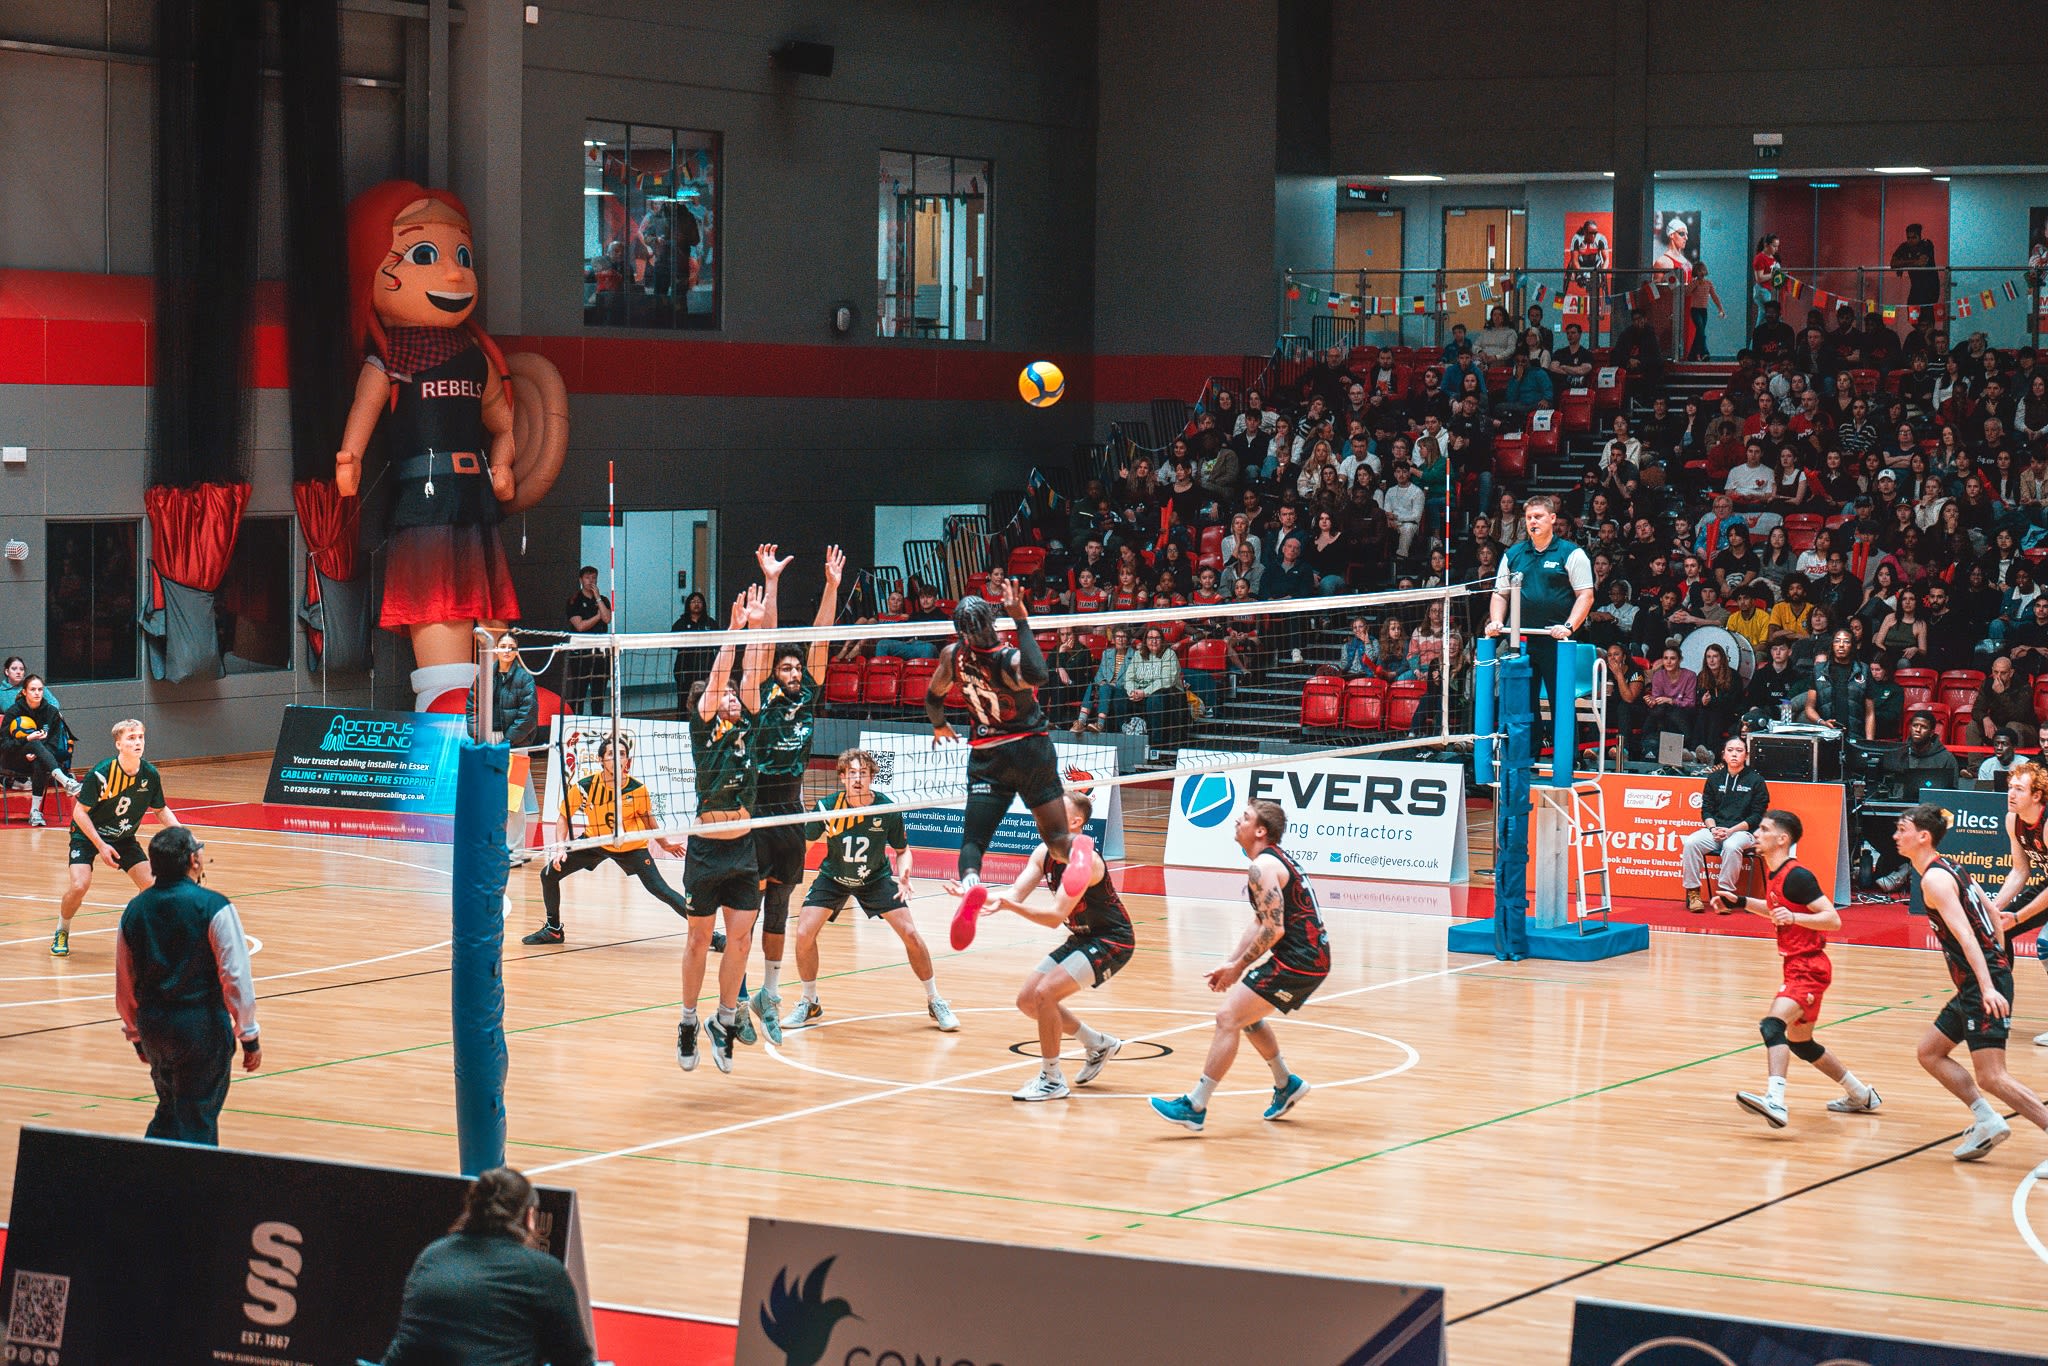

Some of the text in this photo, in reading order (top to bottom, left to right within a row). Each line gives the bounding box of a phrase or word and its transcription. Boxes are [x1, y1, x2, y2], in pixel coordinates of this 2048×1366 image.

[421, 380, 482, 400] REBELS
[344, 720, 414, 735] OCTOPUS
[345, 733, 411, 748] CABLING
[293, 756, 430, 771] Your trusted cabling installer in Essex
[280, 769, 436, 787] CABLING NETWORKS FIRE STOPPING
[340, 789, 426, 800] www.octopuscabling.co.uk
[1249, 769, 1448, 817] EVERS
[115, 796, 131, 816] 8
[1653, 819, 1668, 827] you
[1956, 809, 1998, 829] ilecs
[1316, 822, 1413, 841] contractors
[842, 836, 870, 863] 12
[1343, 853, 1439, 869] office@tjevers.co.uk
[1995, 854, 2013, 867] all
[241, 1330, 291, 1349] EST. 1867
